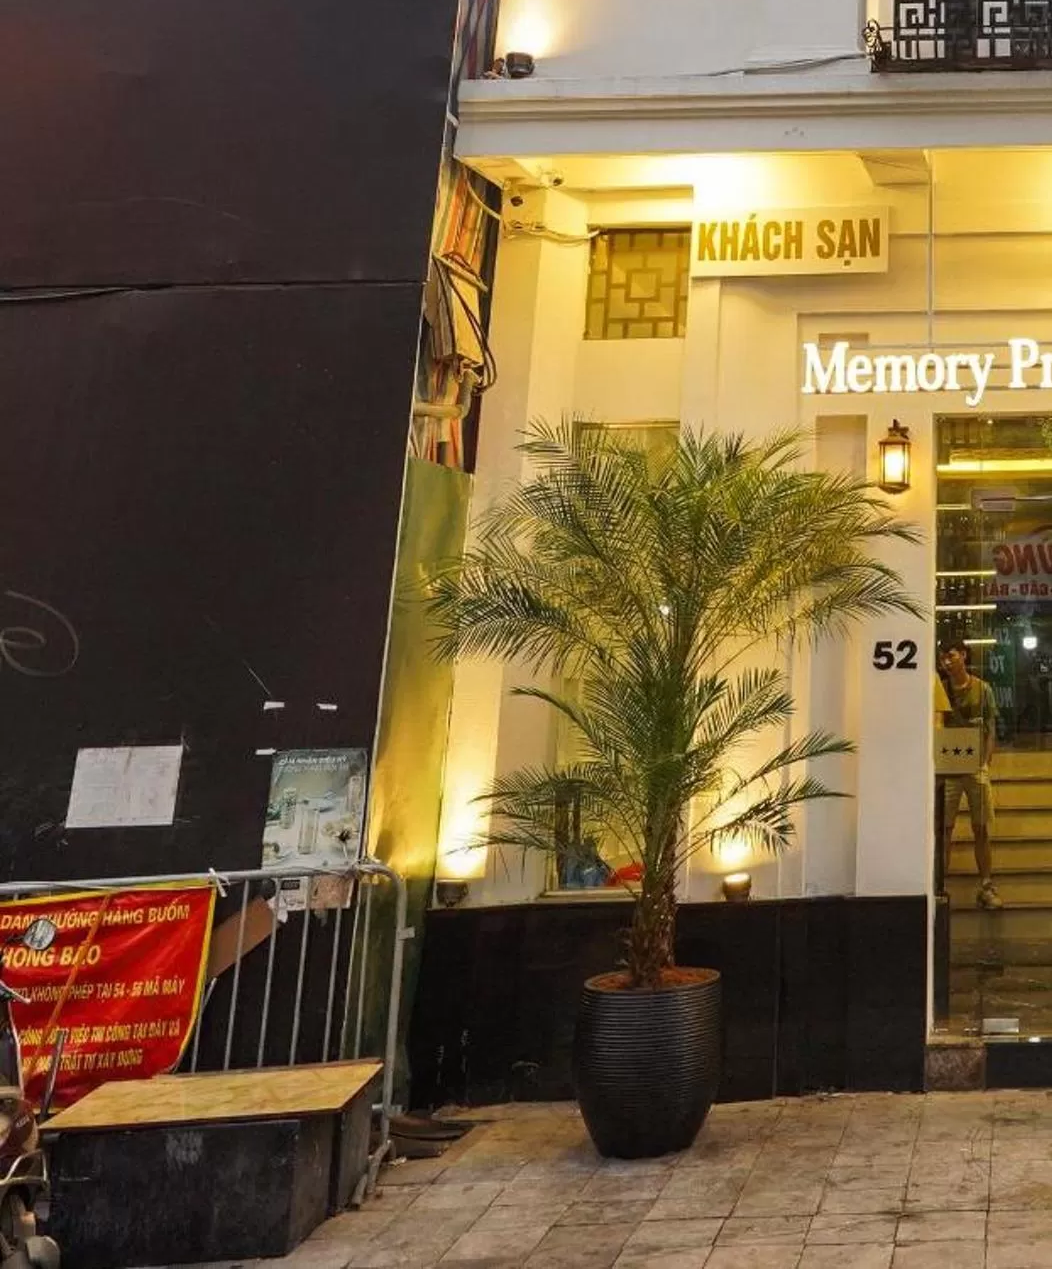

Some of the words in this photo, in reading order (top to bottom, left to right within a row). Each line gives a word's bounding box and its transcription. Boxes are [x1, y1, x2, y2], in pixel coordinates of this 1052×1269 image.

[697, 213, 803, 261] KHÁCH
[816, 218, 880, 266] SẠN
[801, 341, 995, 406] Memory
[872, 639, 918, 671] 52
[36, 907, 100, 929] HƯỜNG
[102, 905, 144, 926] HÀNG
[147, 901, 191, 922] BUỒM
[0, 943, 56, 968] HÔNG
